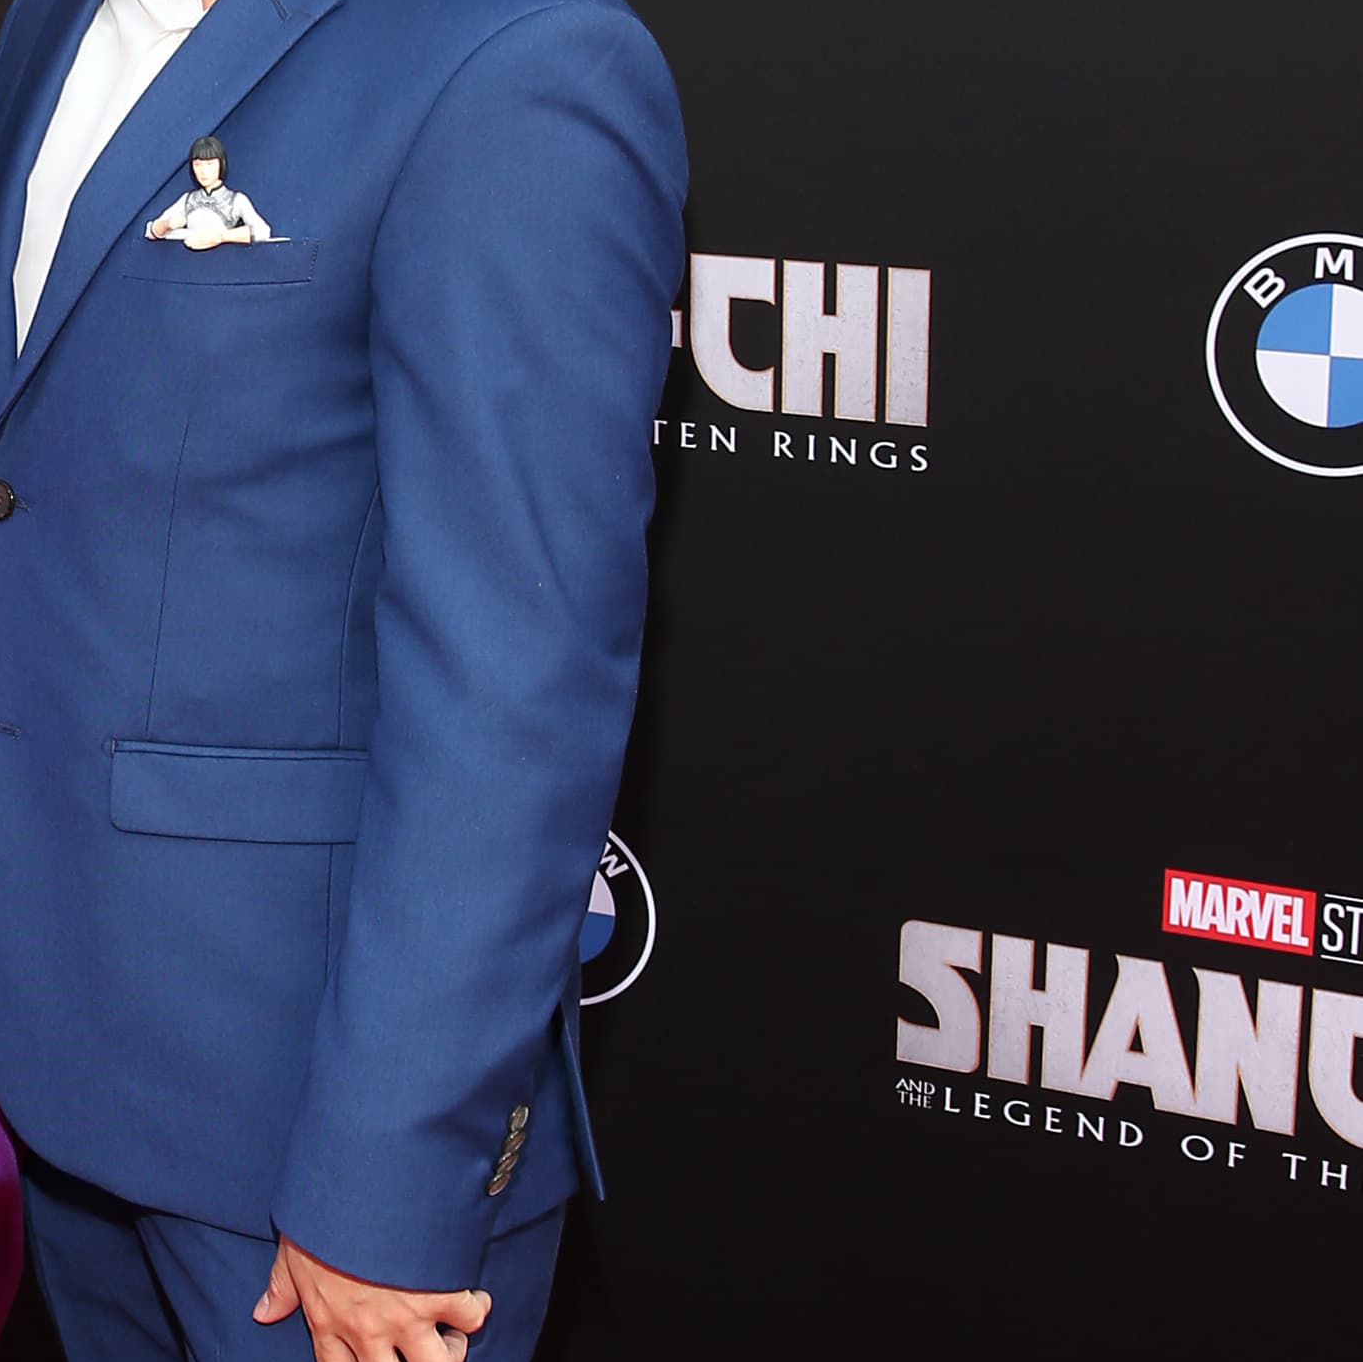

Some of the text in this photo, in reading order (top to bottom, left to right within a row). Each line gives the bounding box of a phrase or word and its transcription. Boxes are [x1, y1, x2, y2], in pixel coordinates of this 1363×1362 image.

[1244, 248, 1354, 308] BM
[654, 420, 927, 471] TEN RINGS
[1170, 878, 1309, 947] MARVEL
[895, 1078, 936, 1095] AND
[897, 1090, 933, 1109] THE
[945, 1087, 1347, 1189] LEGEND OF TH
